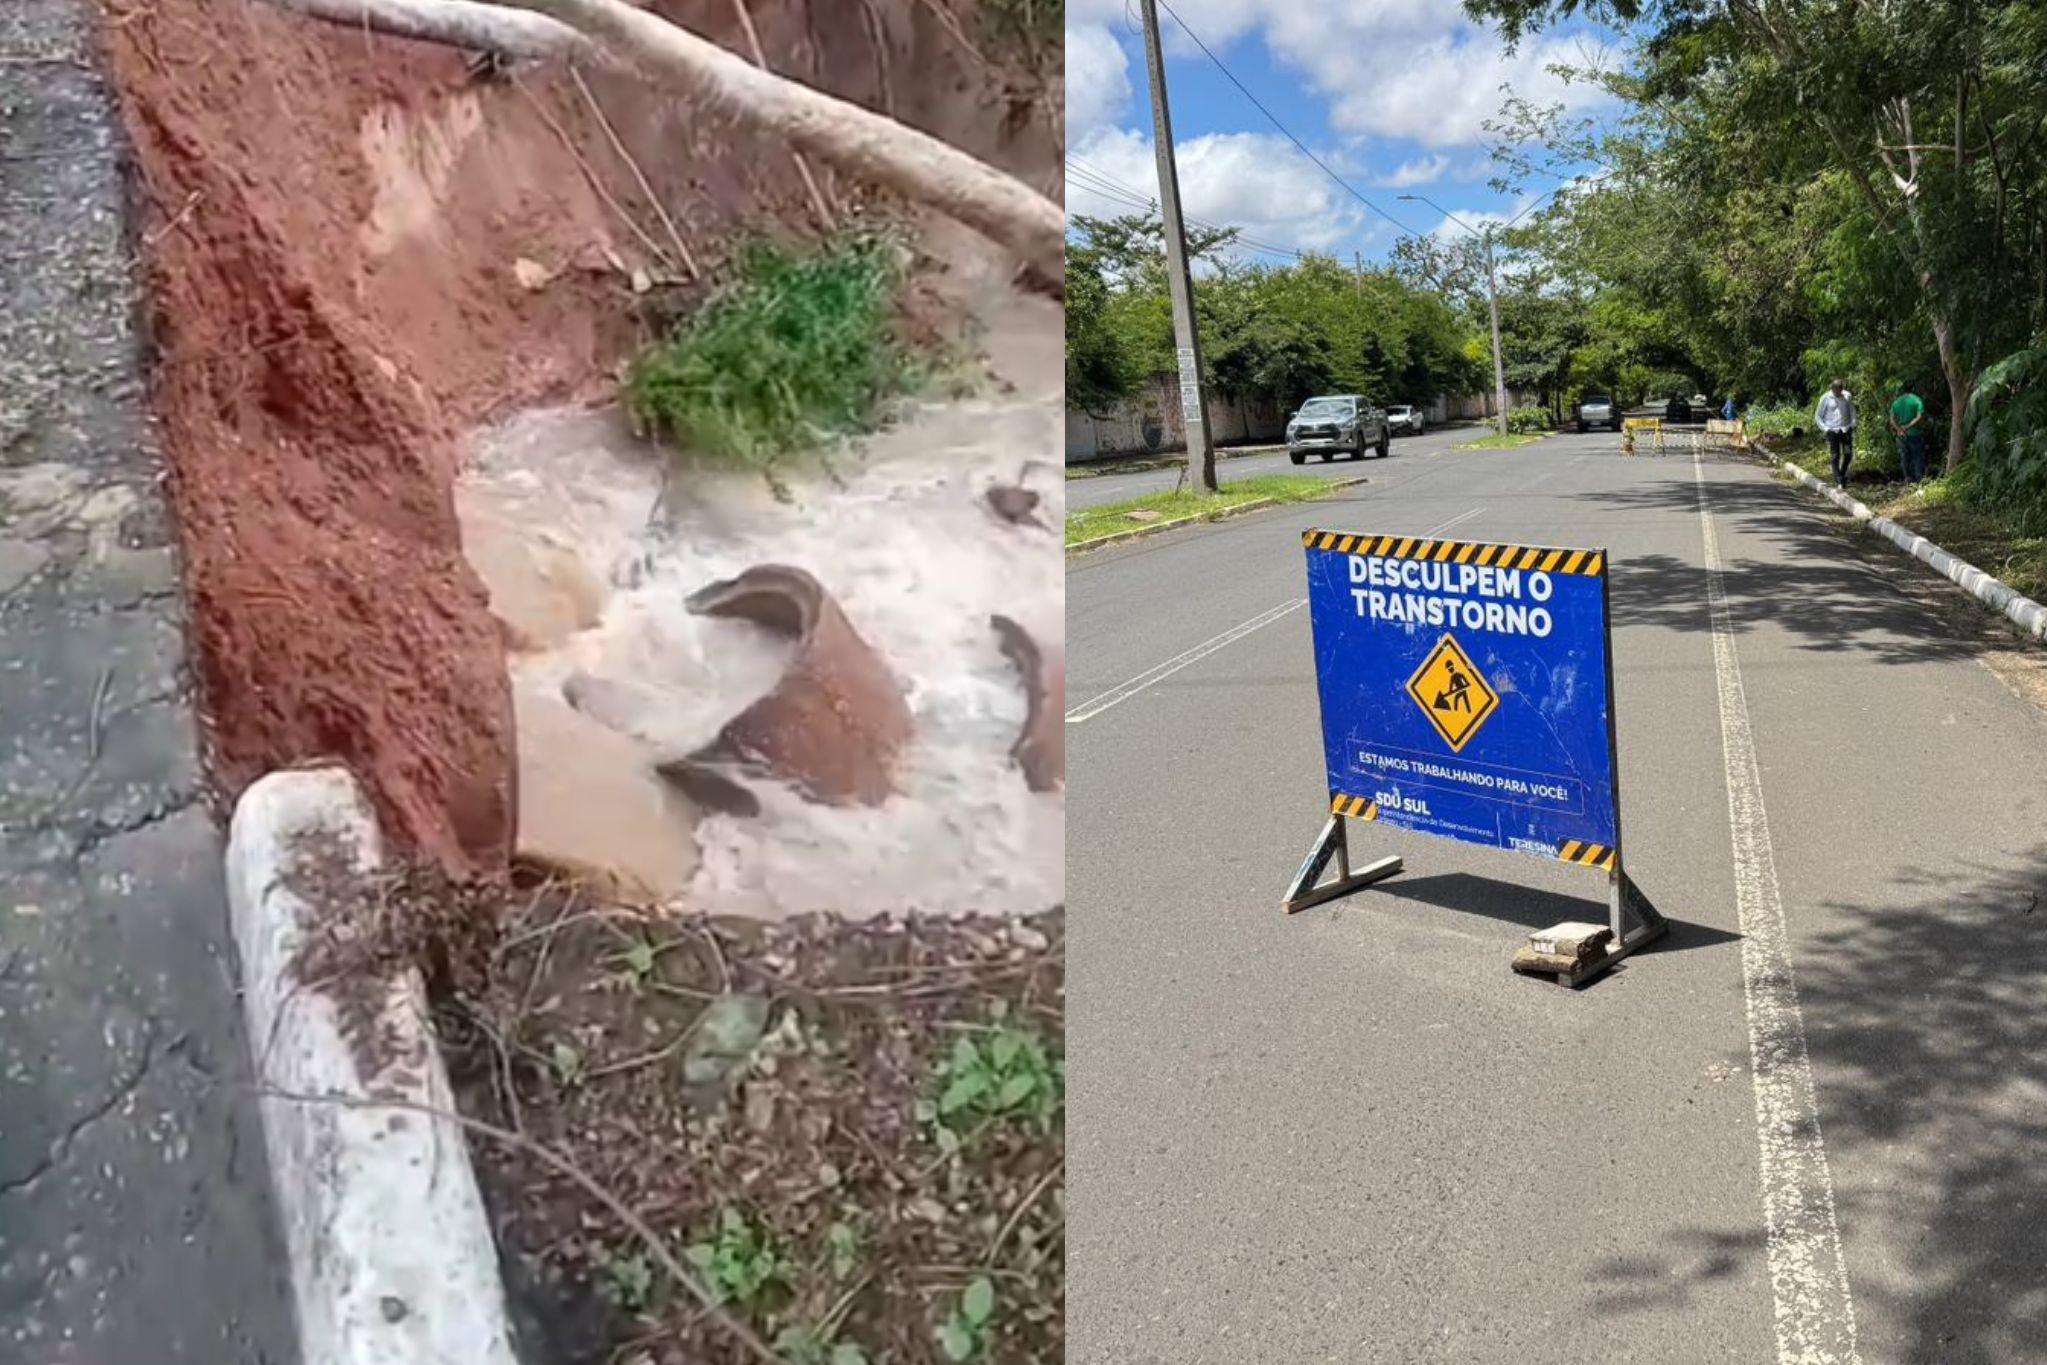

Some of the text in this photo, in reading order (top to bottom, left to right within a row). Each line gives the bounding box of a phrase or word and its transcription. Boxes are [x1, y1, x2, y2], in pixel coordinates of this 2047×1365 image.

[1349, 555, 1553, 602] DESCULPEM O
[1351, 588, 1553, 638] TRANSTORNO
[1359, 751, 1568, 801] ESTAMOS TRABALHANDO PARA VOCÊ!
[1375, 790, 1431, 816] SDU SUL
[1508, 836, 1559, 856] TERESINA
